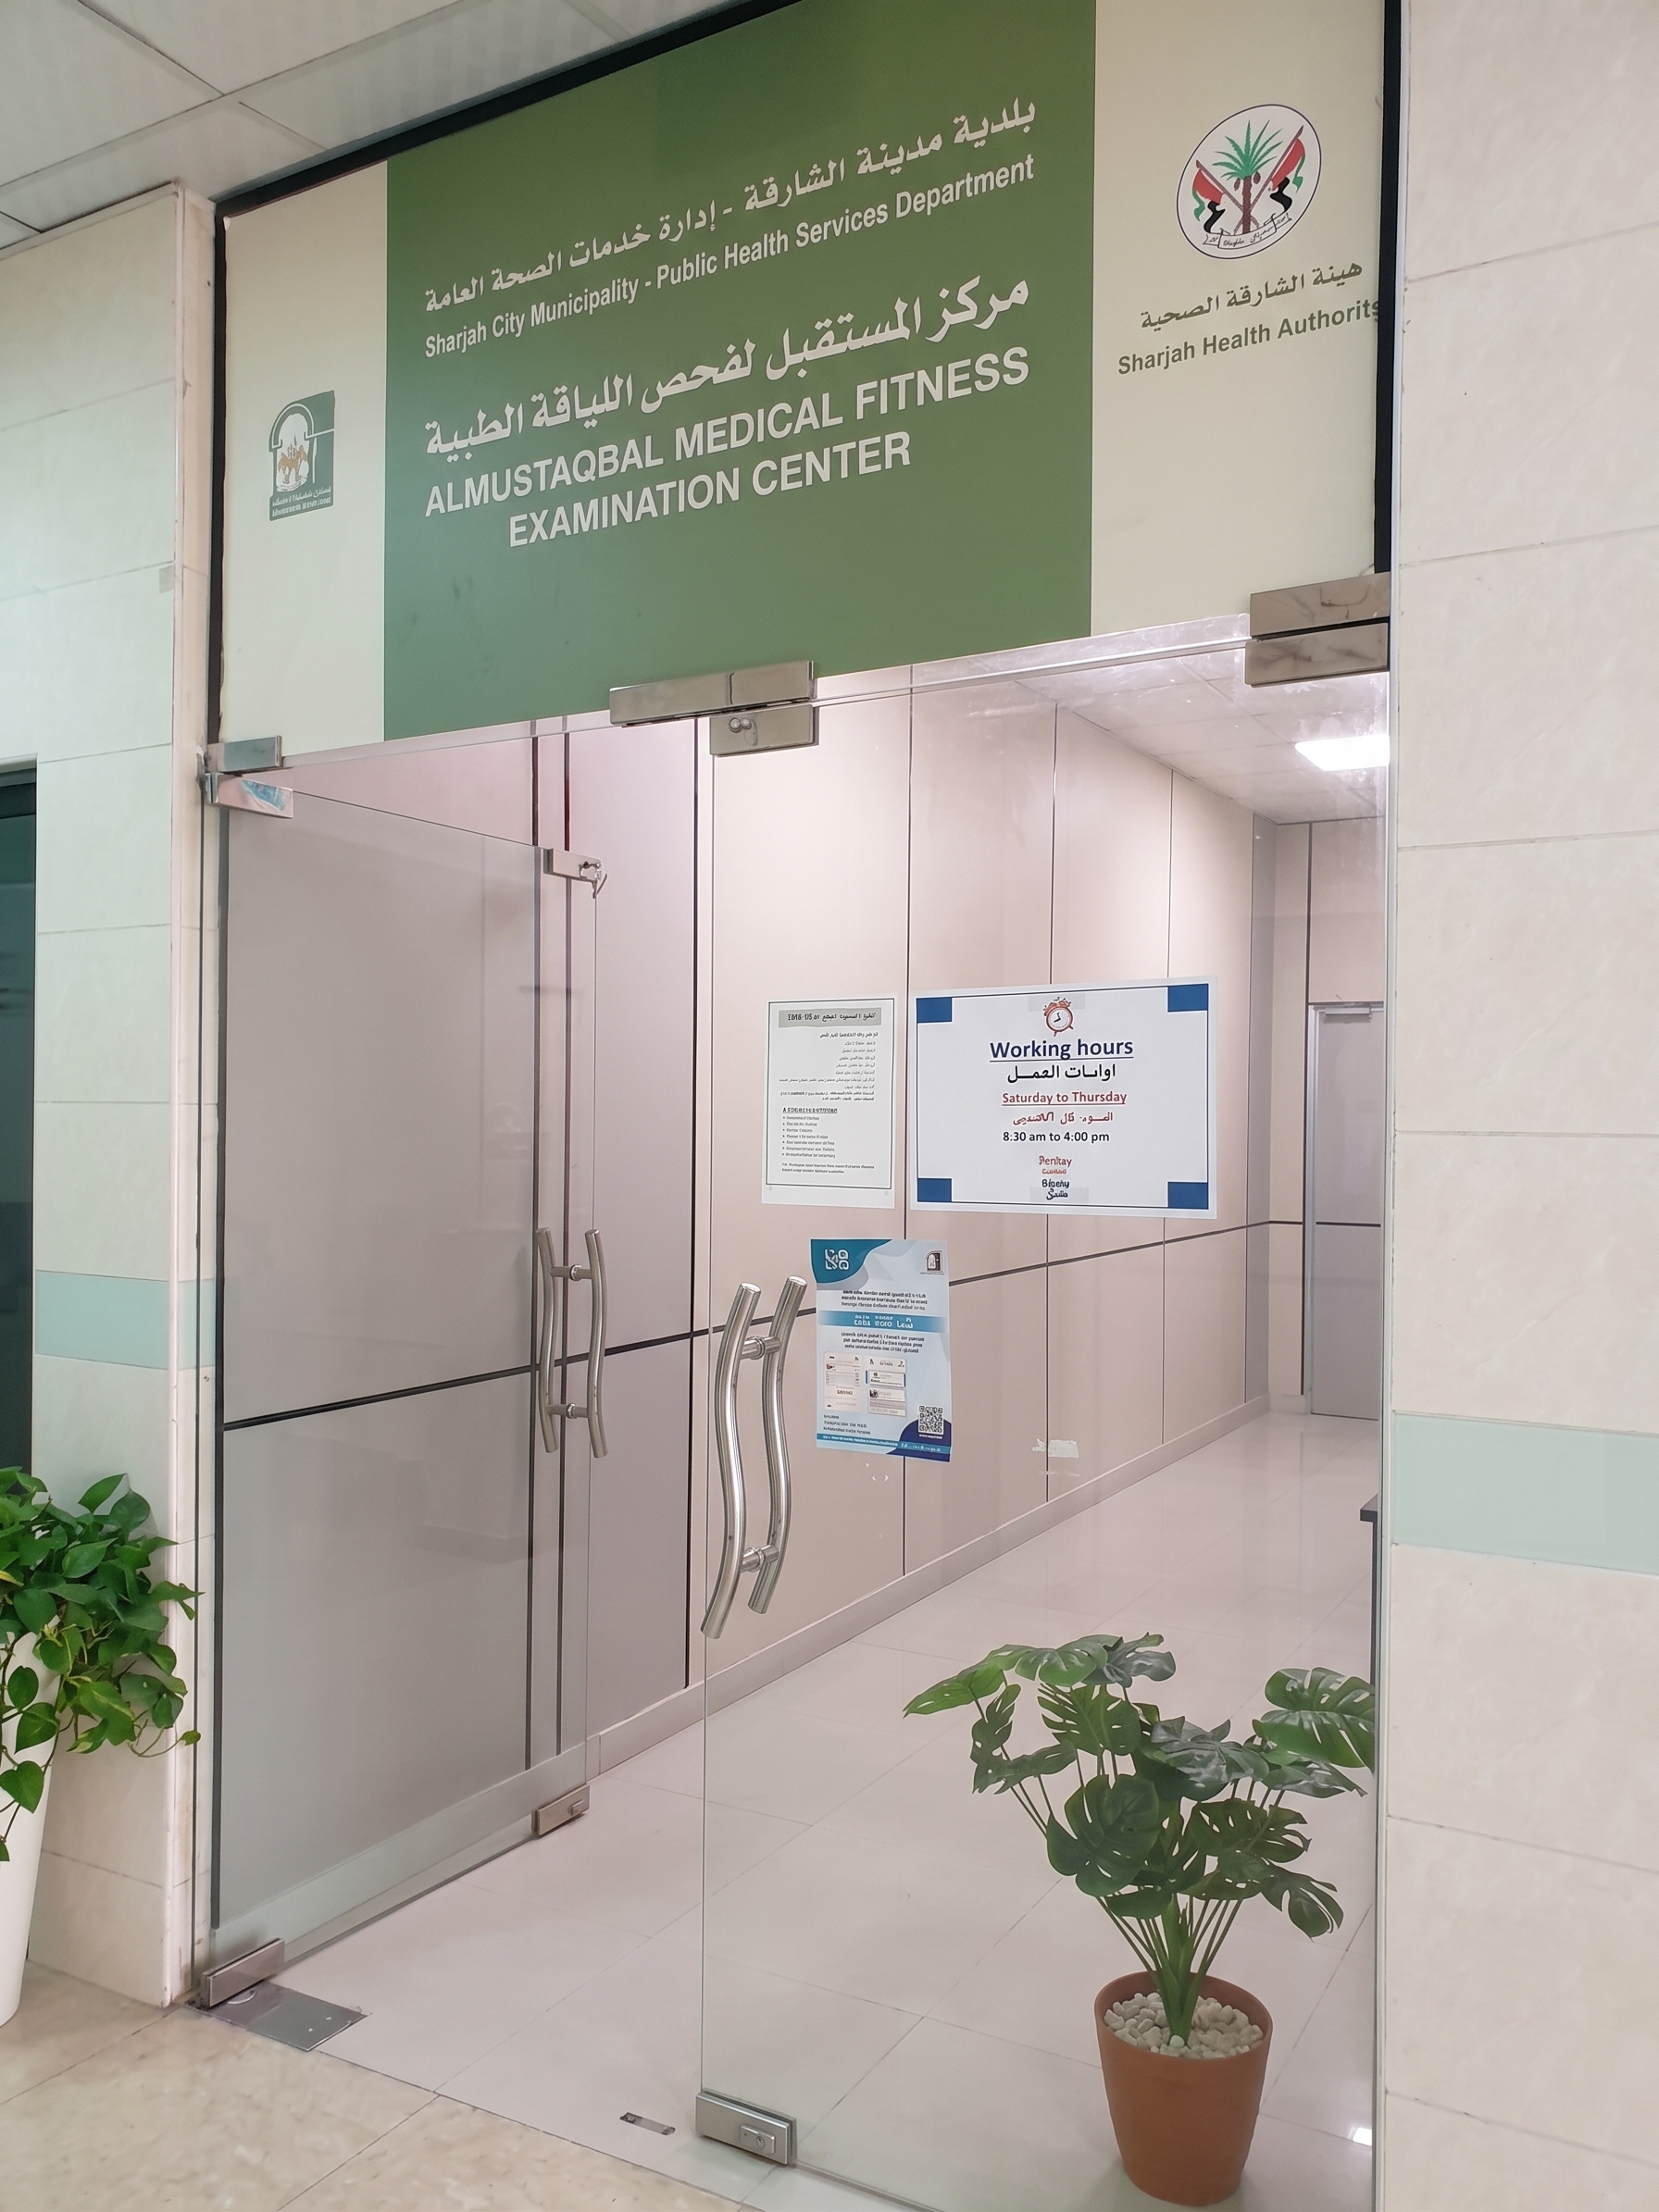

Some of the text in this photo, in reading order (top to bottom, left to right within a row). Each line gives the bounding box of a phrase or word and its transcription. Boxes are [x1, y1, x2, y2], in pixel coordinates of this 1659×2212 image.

[953, 96, 1036, 149] بلدية
[856, 143, 942, 176] مدينة
[743, 156, 845, 211] الشارقة
[658, 199, 717, 242] إدارة
[425, 320, 487, 358] Sharjah
[492, 311, 526, 338] City
[530, 277, 640, 316] Municipality
[656, 252, 717, 290] Public
[724, 229, 789, 269] Health
[795, 203, 889, 248] Services
[895, 153, 1034, 218] Department
[568, 223, 652, 267] خدمات
[491, 249, 563, 292] الصحة
[1226, 272, 1305, 307] الشارقة
[425, 275, 485, 312] العامة
[1140, 294, 1219, 333] الصحية
[424, 275, 1029, 463] مركز المستقبل لفحص اللياقة الطبية
[1117, 341, 1195, 375] Sharjah
[1203, 323, 1270, 356] Health
[425, 346, 1029, 517] ALMUSTAQBAL MEDICAL FITNESS
[509, 430, 911, 548] EXAMINATION CENTER
[989, 1038, 1134, 1061] Working hours
[1002, 1090, 1128, 1106] Saturday to Thursday
[1003, 1131, 1110, 1144] 8:30 am to 4:00 pm
